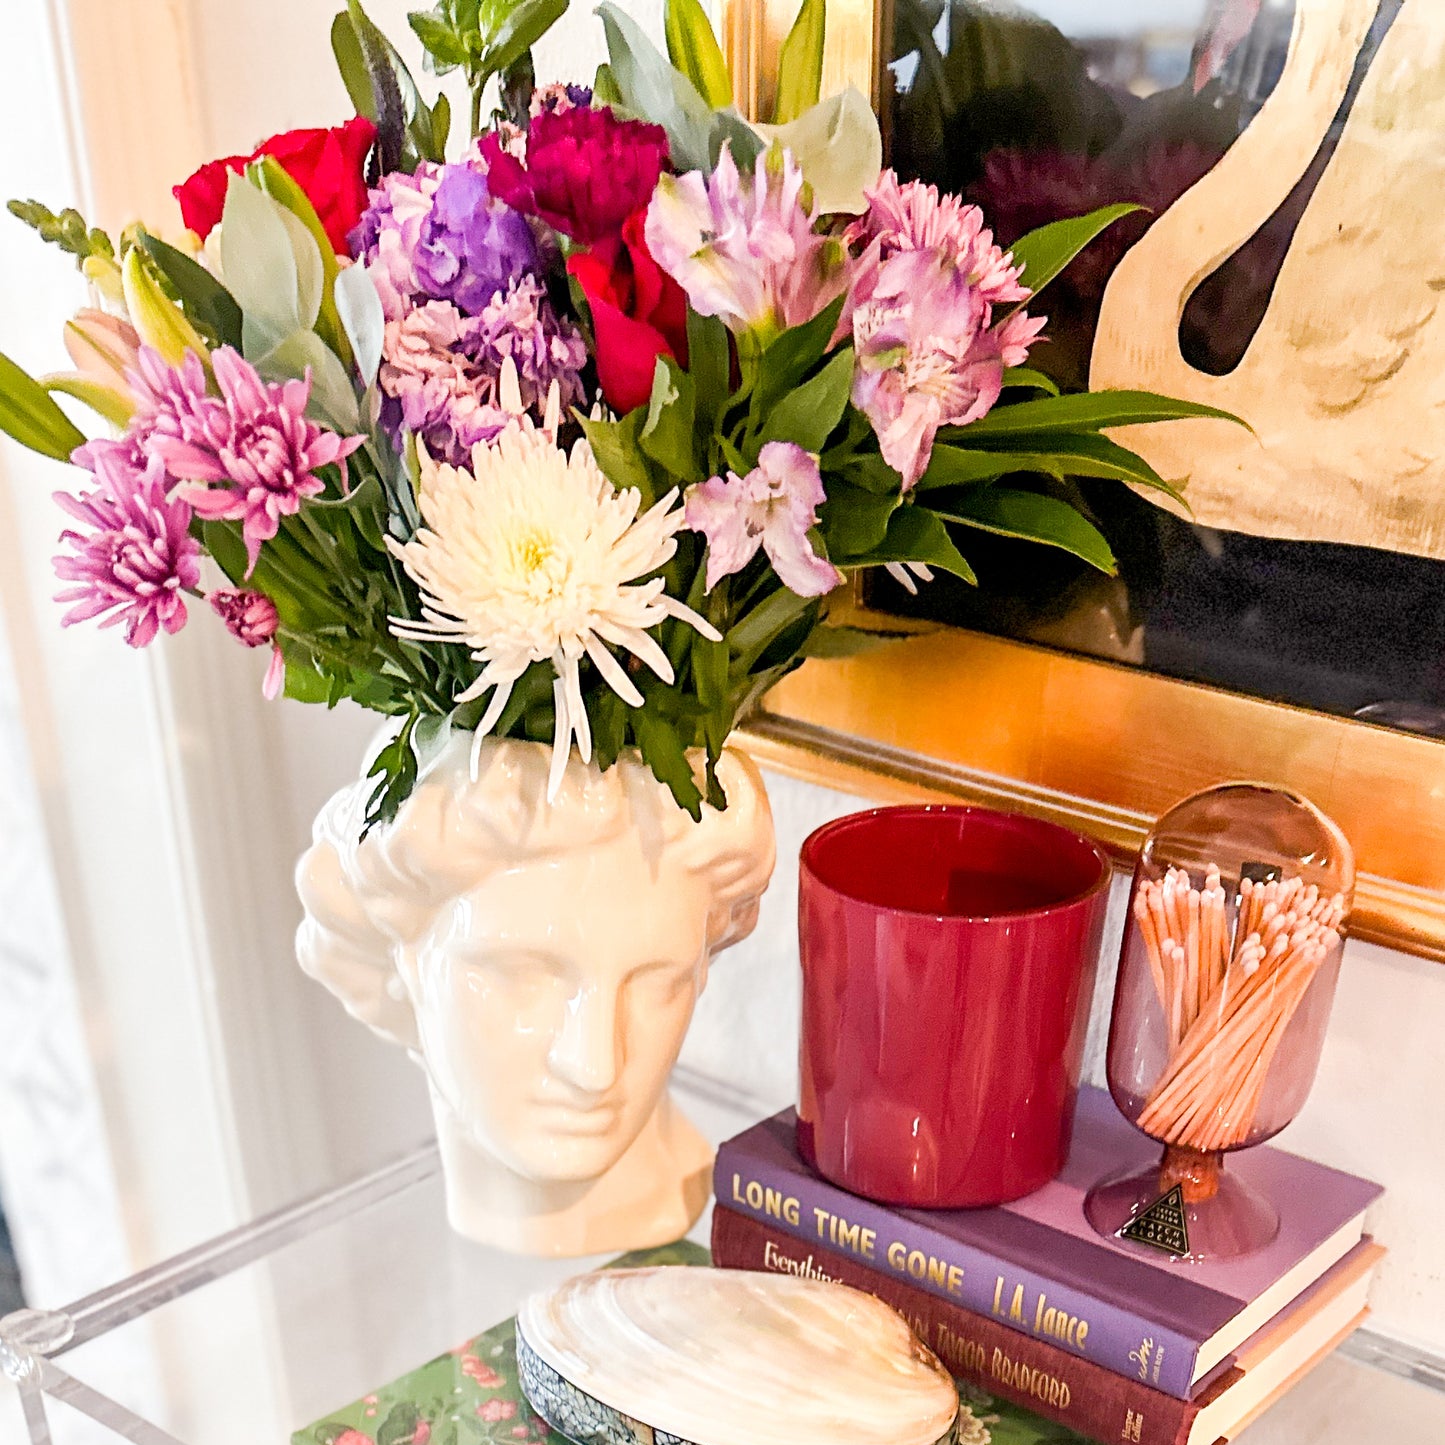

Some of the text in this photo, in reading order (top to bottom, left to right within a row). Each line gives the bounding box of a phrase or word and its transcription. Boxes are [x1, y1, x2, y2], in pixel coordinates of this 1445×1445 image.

[732, 1173, 965, 1297] LONG TIME GONE
[991, 1345, 1072, 1410] BRADFORD
